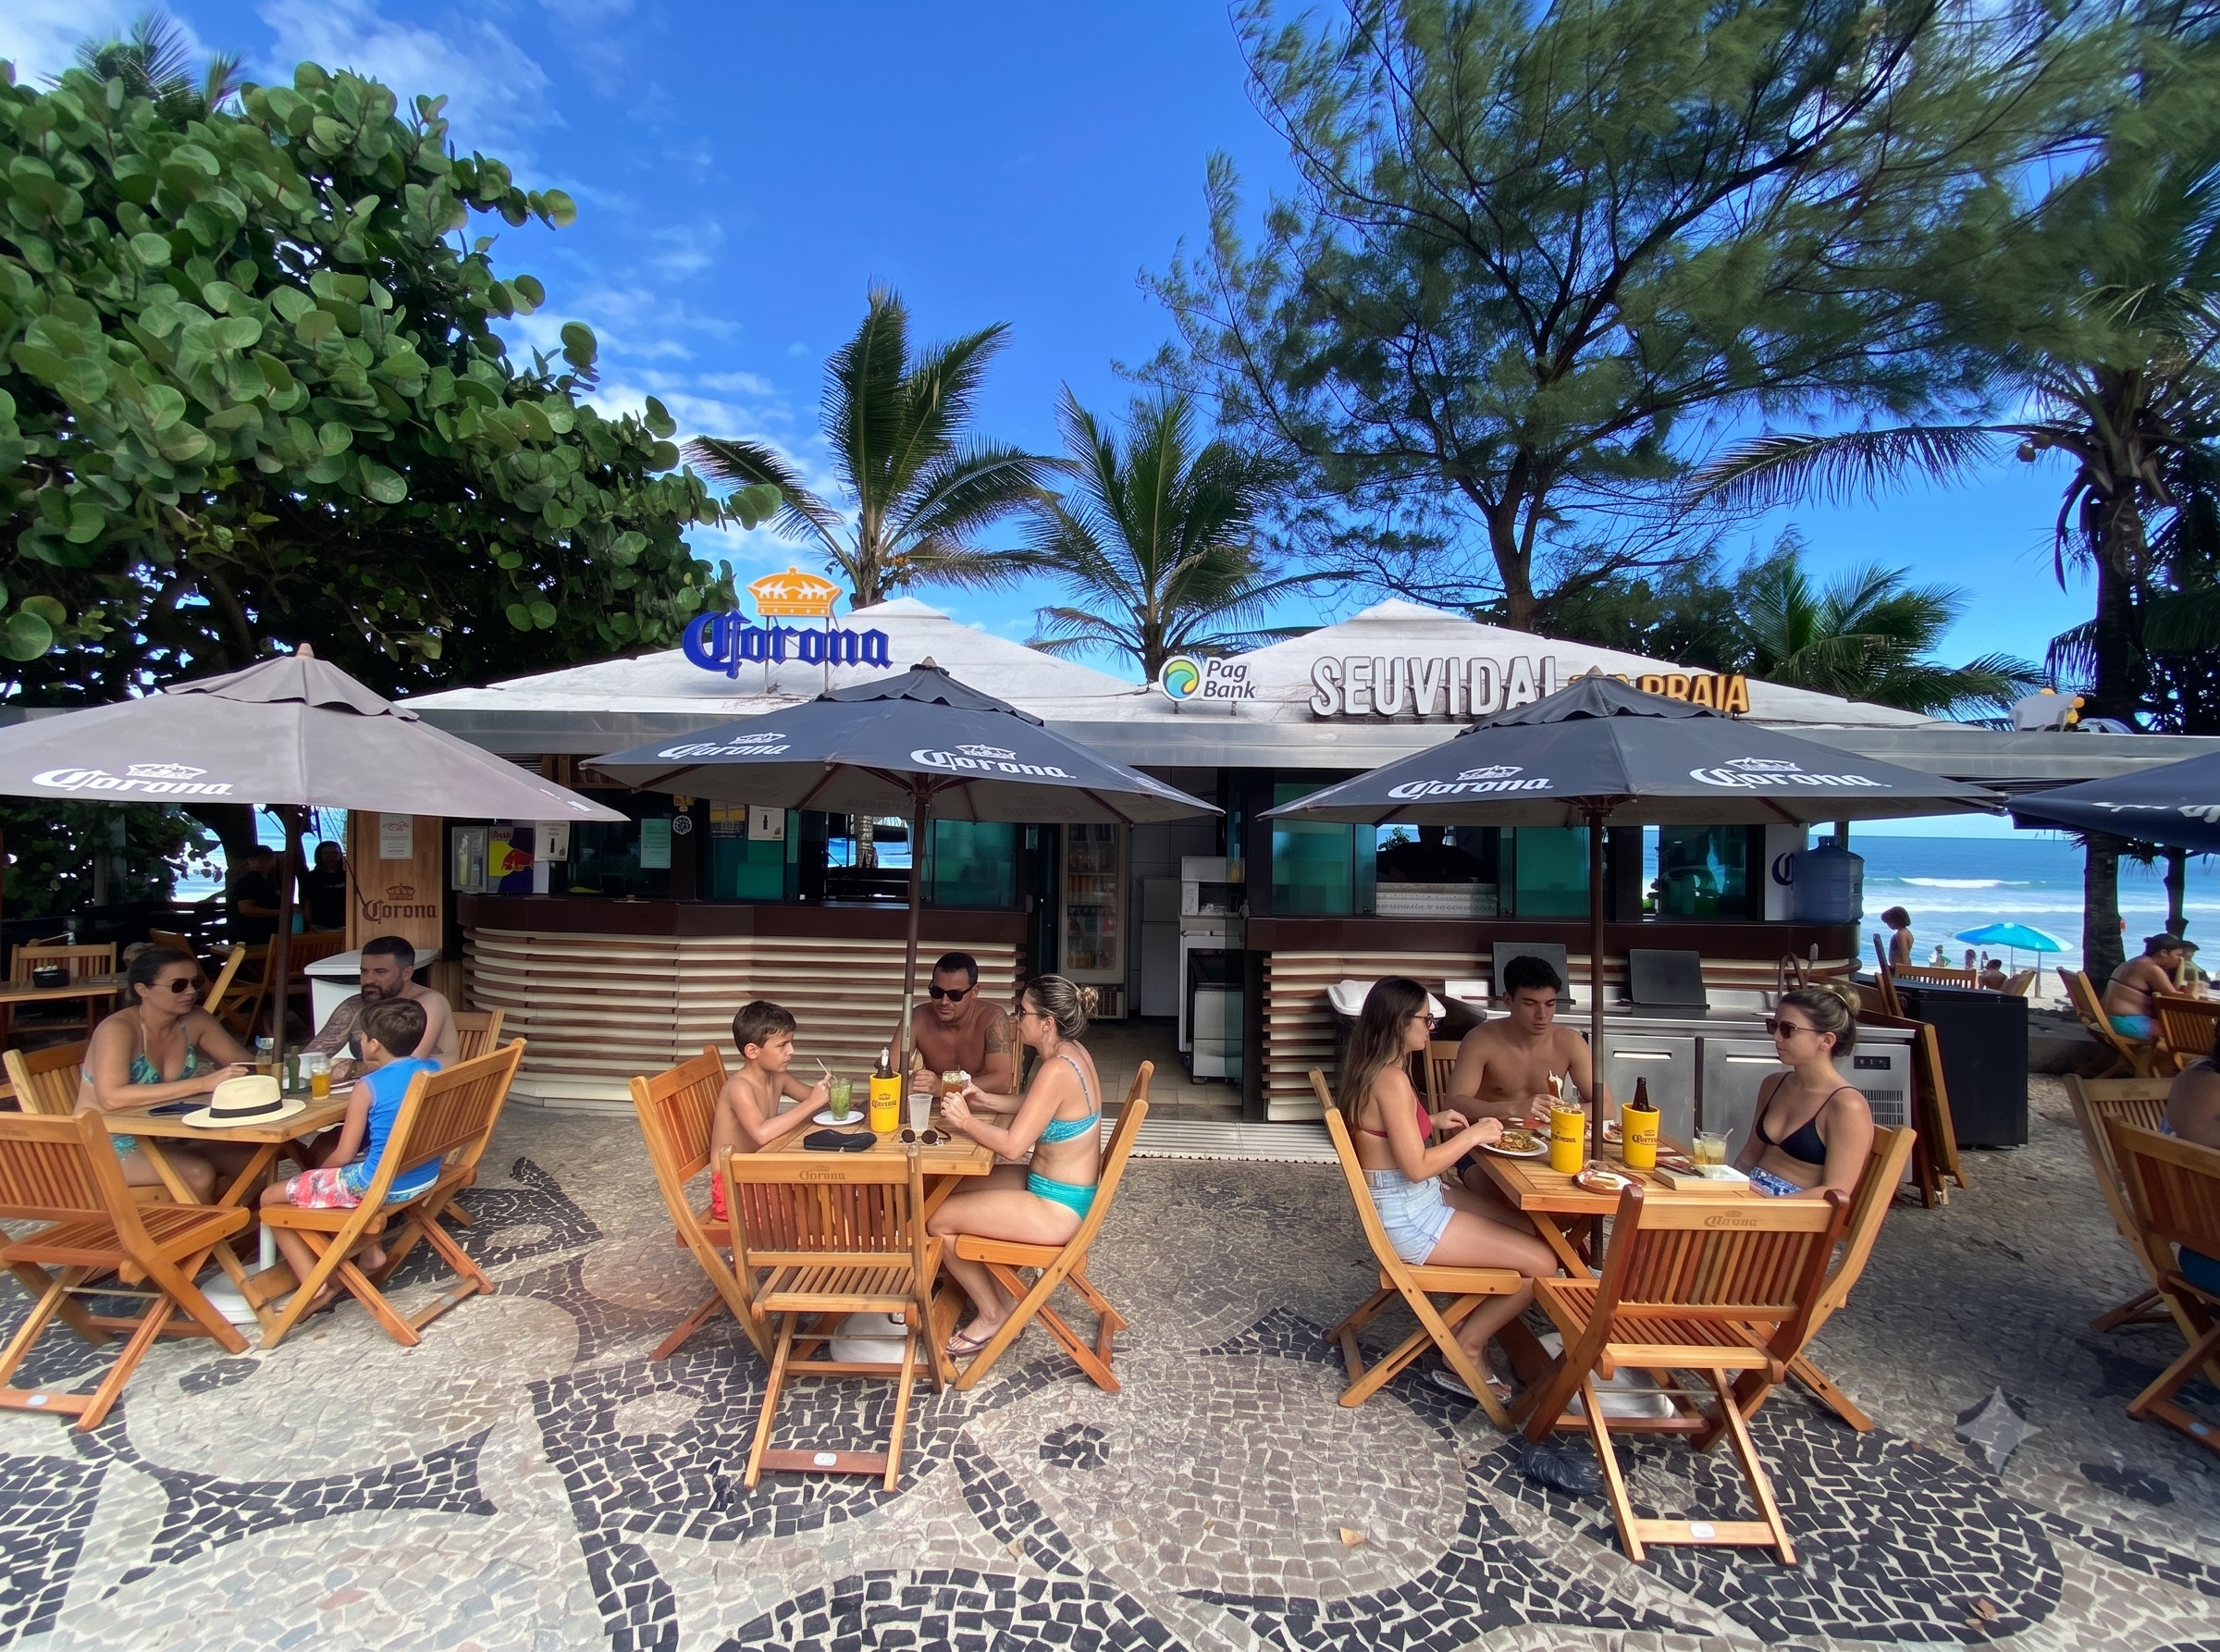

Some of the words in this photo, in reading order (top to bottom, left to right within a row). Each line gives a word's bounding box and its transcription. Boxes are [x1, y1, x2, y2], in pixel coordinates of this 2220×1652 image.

[682, 608, 894, 680] Corona
[1206, 660, 1248, 683] Pag
[1203, 680, 1256, 698] Bank
[658, 742, 791, 760] Corona
[910, 749, 1077, 779] Corona
[31, 768, 235, 795] Corona
[1388, 777, 1553, 799] Corona
[1689, 768, 1888, 789] Corona
[362, 899, 437, 924] Corona
[798, 1169, 846, 1181] Corona
